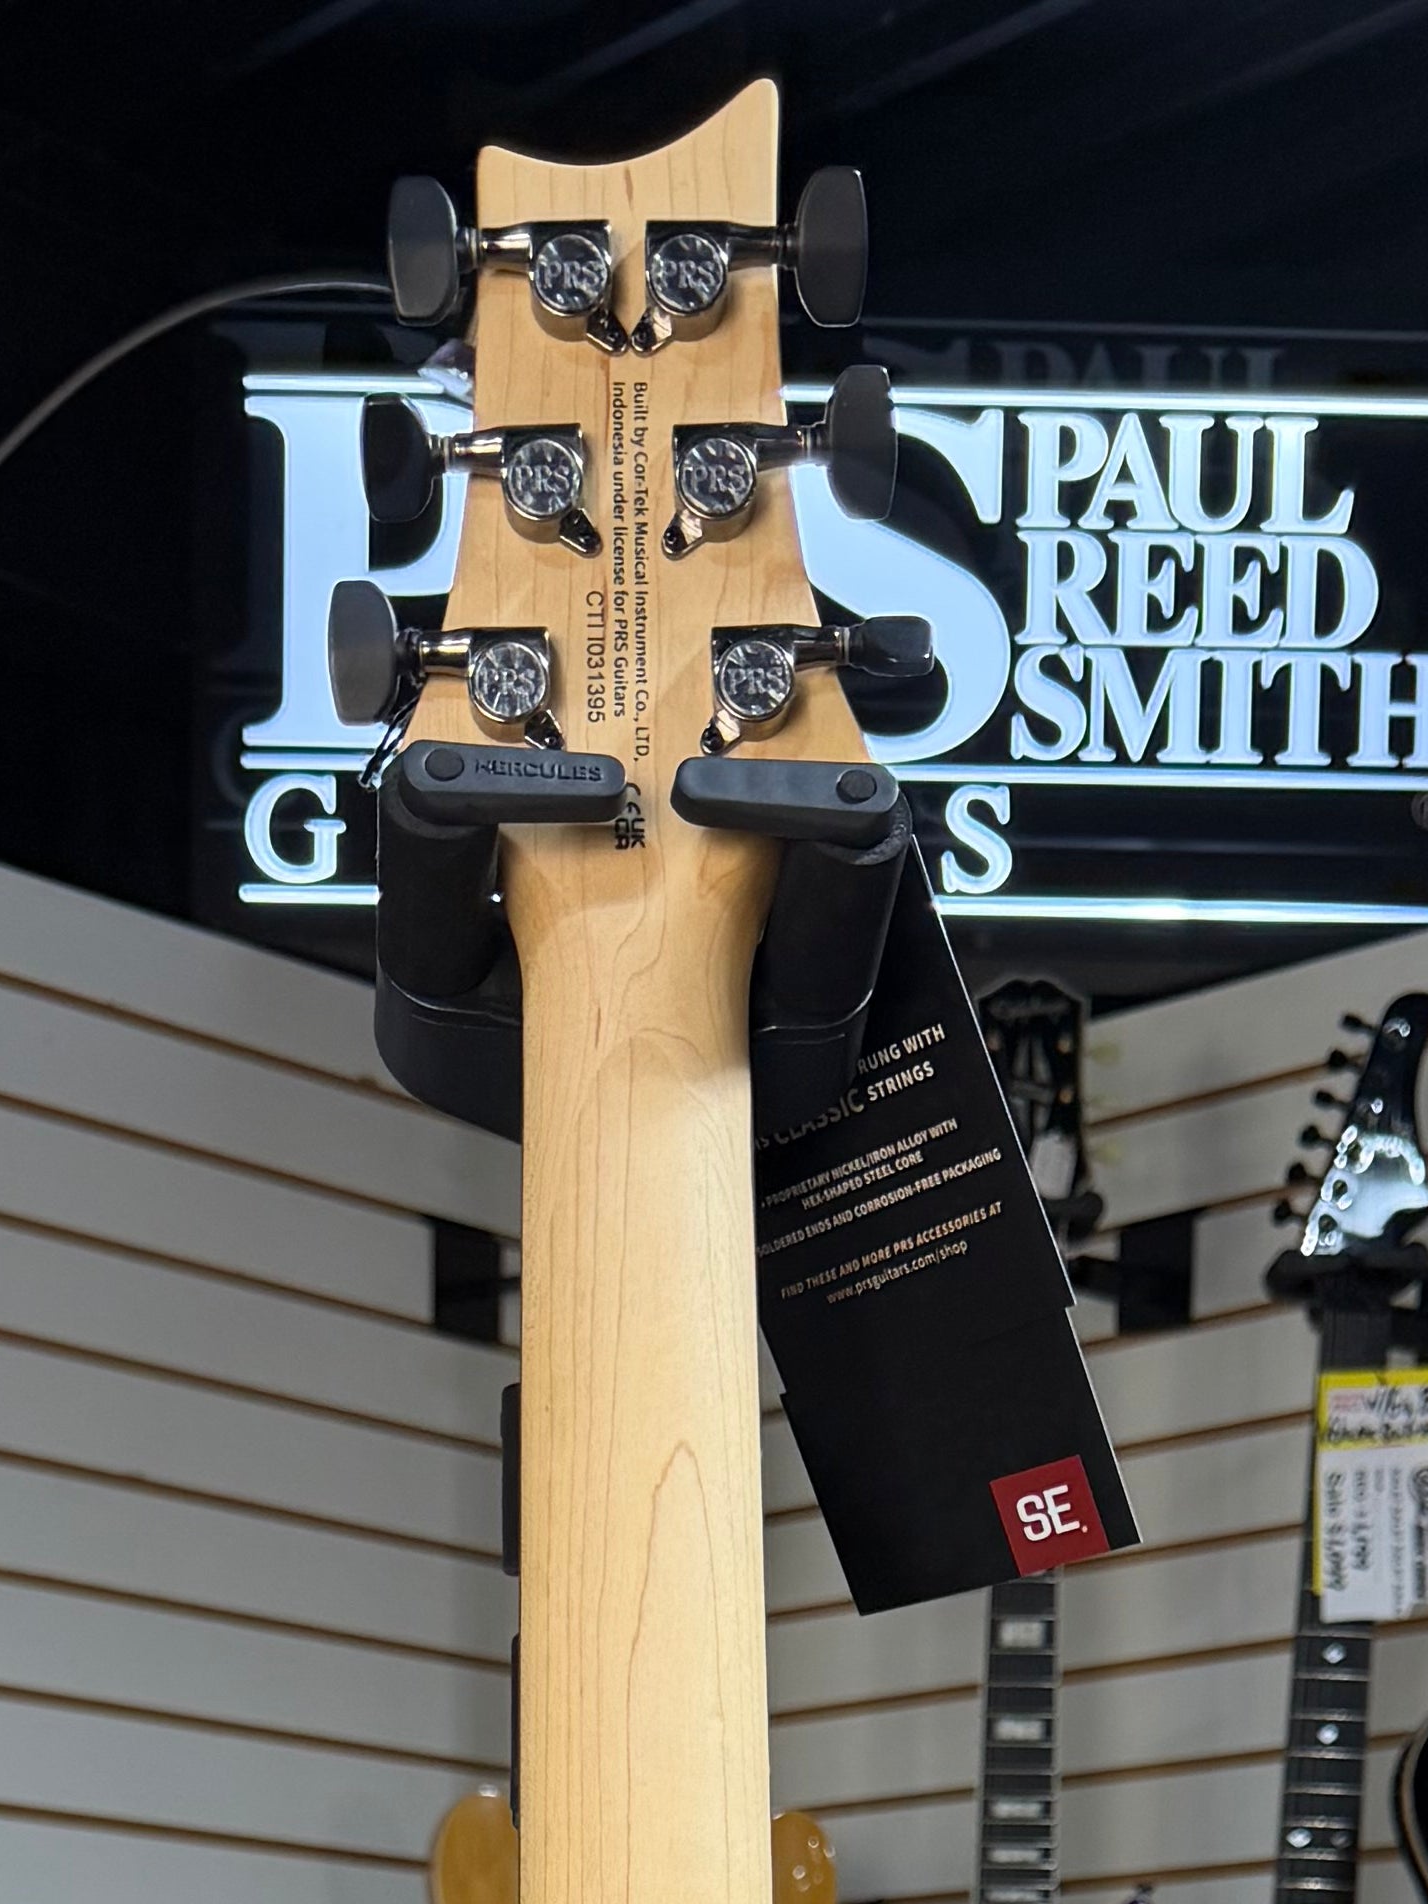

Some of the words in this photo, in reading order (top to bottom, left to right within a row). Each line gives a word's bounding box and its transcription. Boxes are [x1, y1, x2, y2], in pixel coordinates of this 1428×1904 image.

[544, 261, 603, 288] PRS
[664, 261, 719, 290] PRS
[612, 382, 628, 466] Indonesia
[632, 382, 648, 421] Built
[631, 426, 647, 448] by
[514, 465, 569, 494] PRS
[613, 471, 628, 523] under
[633, 451, 649, 518] Cor-Tek
[690, 464, 746, 492] PRS
[1019, 410, 1358, 537] PAUL
[613, 526, 629, 586] license
[633, 521, 650, 586] Musical
[614, 591, 629, 615] for
[1019, 529, 1380, 652] REED
[614, 618, 629, 652] PRS
[633, 590, 650, 684] Instrument
[481, 667, 537, 696] PRS
[614, 657, 629, 717] Guitars
[727, 666, 786, 695] PRS
[475, 759, 603, 782] HERCULES
[901, 1023, 946, 1055] WITH
[867, 1060, 935, 1102] STRINGS
[766, 1171, 832, 1207] PROPRIETARY
[896, 1131, 928, 1154] ALLOY
[927, 1117, 958, 1142] WITH
[801, 1176, 864, 1211] HEX-SHAPED
[864, 1164, 894, 1186] STEEL
[894, 1150, 925, 1172] CORE
[804, 1217, 832, 1239] ENDS
[831, 1208, 854, 1227] AND
[853, 1171, 942, 1219] CORROSION-FREE
[942, 1147, 1003, 1183] PACKAGING
[780, 1277, 805, 1300] FIND
[804, 1266, 838, 1290] THESE
[838, 1258, 861, 1279] AND
[861, 1246, 892, 1269] MORE
[893, 1236, 915, 1256] PRS
[915, 1209, 988, 1248] ACCESSORIES
[987, 1200, 1003, 1218] AT
[825, 1239, 969, 1305] www.prsguitars.com/shop
